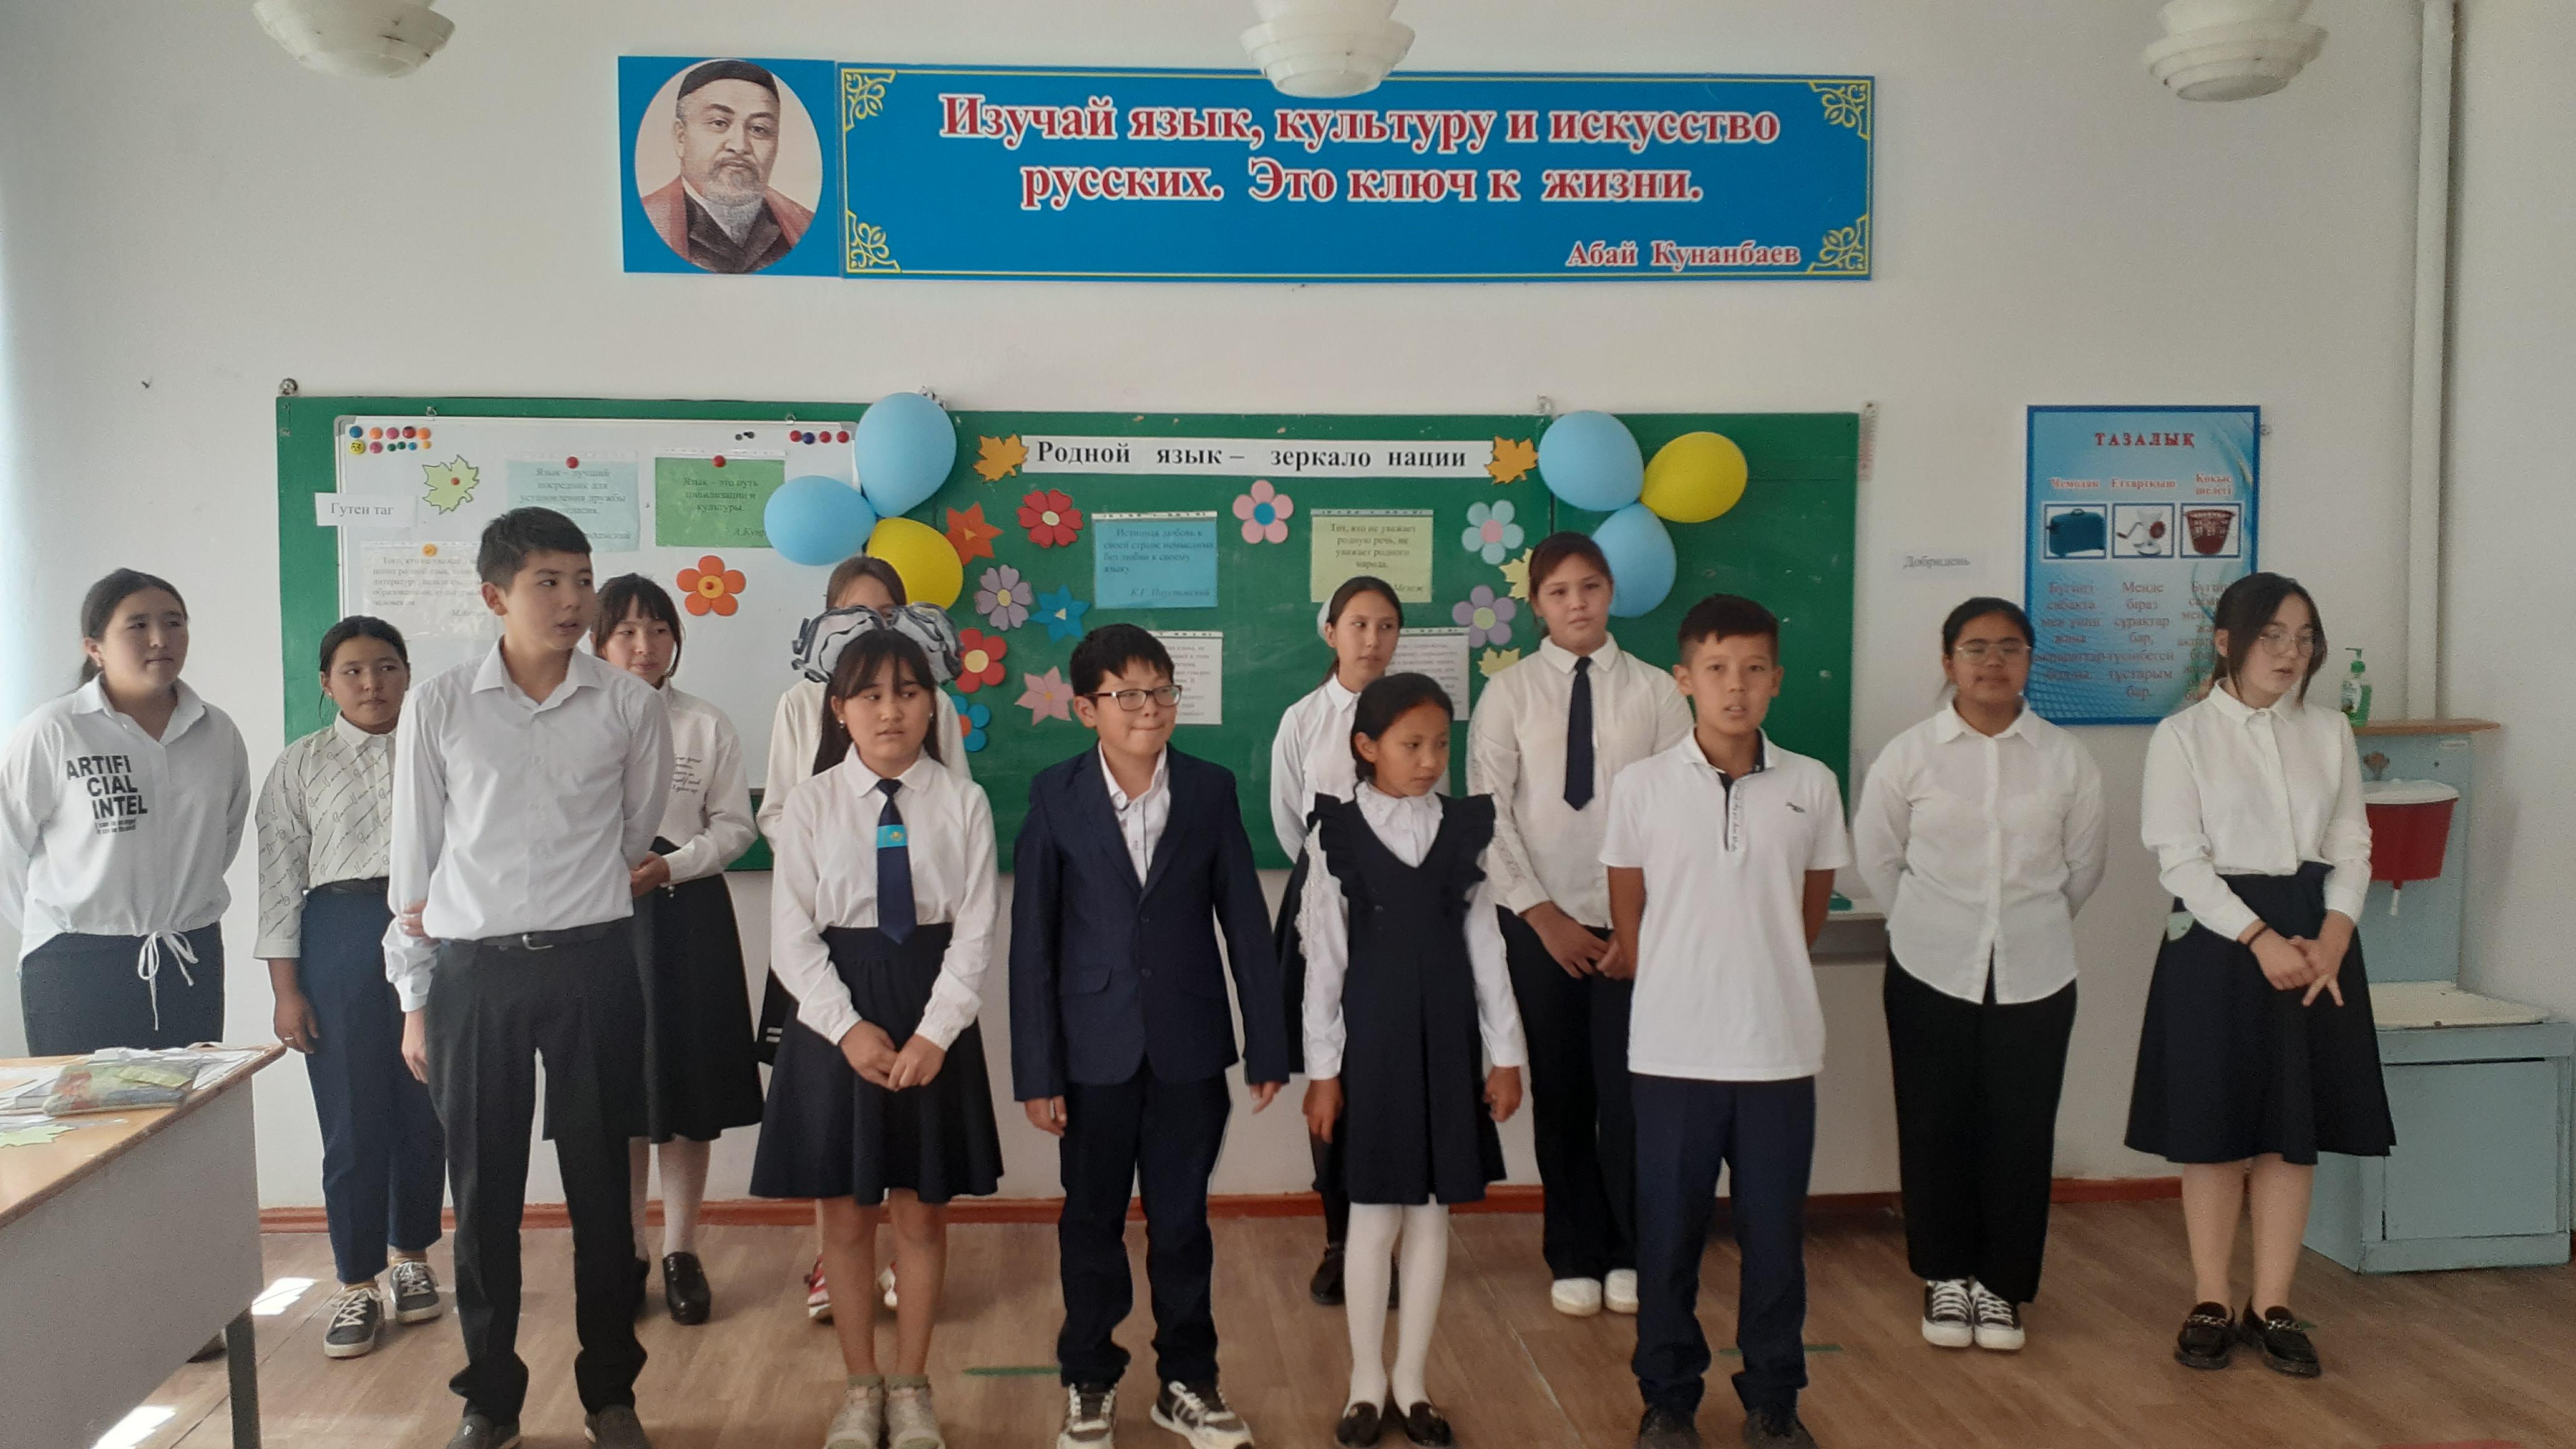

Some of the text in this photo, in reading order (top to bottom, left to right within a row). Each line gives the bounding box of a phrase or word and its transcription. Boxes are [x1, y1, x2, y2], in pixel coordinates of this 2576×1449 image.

[939, 93, 1780, 154] Изучай язык, культуру и искусство
[1020, 157, 1704, 210] русских. Это ключ к жизни.
[1565, 238, 1801, 272] Абай Кунанбаев
[2095, 432, 2195, 447] ТАЗАЛЫҚ
[1037, 441, 1130, 464] Родной
[1157, 449, 1222, 465] язык
[1271, 449, 1371, 471] зеркало
[1388, 451, 1466, 469] нации
[331, 503, 394, 517] Гутен таг
[66, 755, 132, 780] ARTIFI
[87, 775, 138, 797] CIAL
[92, 795, 149, 819] INTEL
